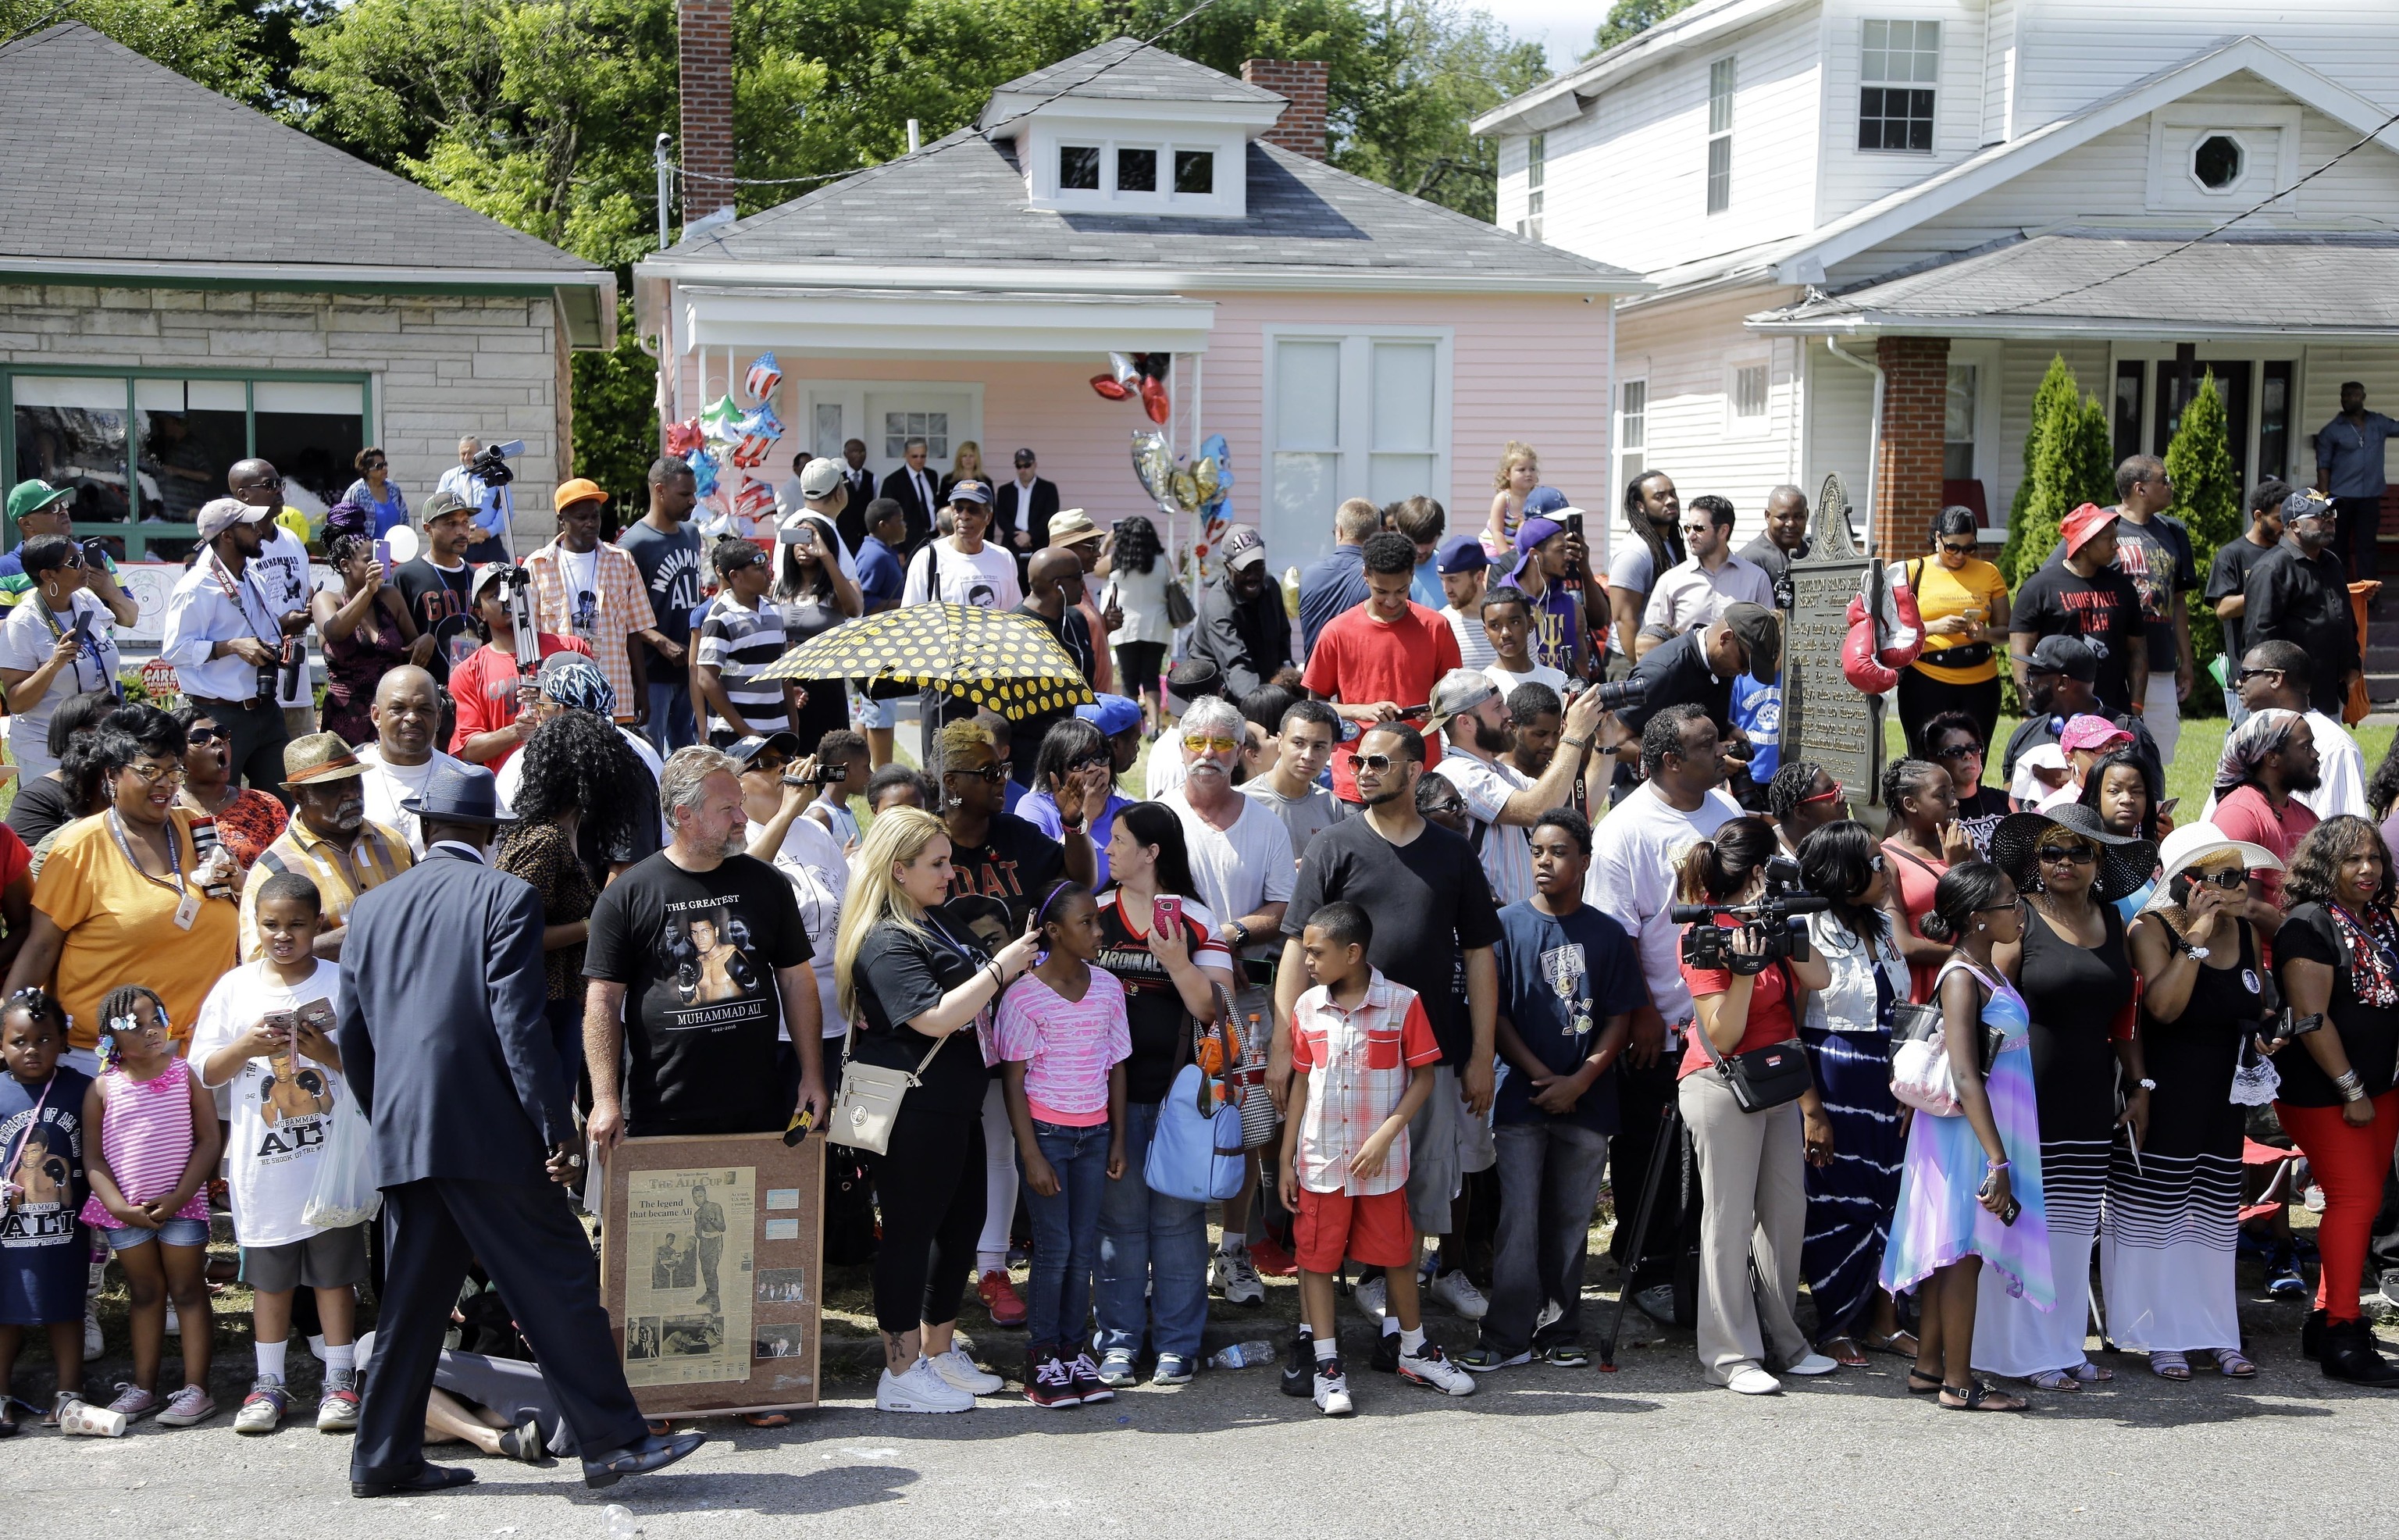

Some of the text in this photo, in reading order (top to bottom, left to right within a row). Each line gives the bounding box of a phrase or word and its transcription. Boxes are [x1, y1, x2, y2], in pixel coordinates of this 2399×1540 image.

[1232, 533, 1253, 552] ALI
[256, 556, 298, 572] MUHAMMAD
[651, 548, 700, 594] MUHAMM
[218, 571, 228, 583] EOS
[2059, 591, 2119, 611] LOUISVILLE
[2080, 611, 2108, 634] MAN
[144, 668, 176, 682] CARE
[947, 860, 1022, 899] OAT
[665, 894, 740, 912] THE GREATEST
[1546, 947, 1577, 967] FREE
[1550, 958, 1576, 976] GAS!
[677, 1003, 761, 1025] MUHAMMAD ALI
[711, 1024, 736, 1033] 1942-2016
[246, 1061, 257, 1078] THE
[43, 1107, 59, 1122] OF
[56, 1111, 77, 1133] ALL
[273, 1113, 320, 1129] MUHAMMAD
[271, 1154, 293, 1164] SHOOK
[303, 1146, 315, 1155] THE
[18, 1202, 59, 1213] MUHAMMAD
[657, 1199, 683, 1210] legend
[0, 1210, 76, 1239] ALI
